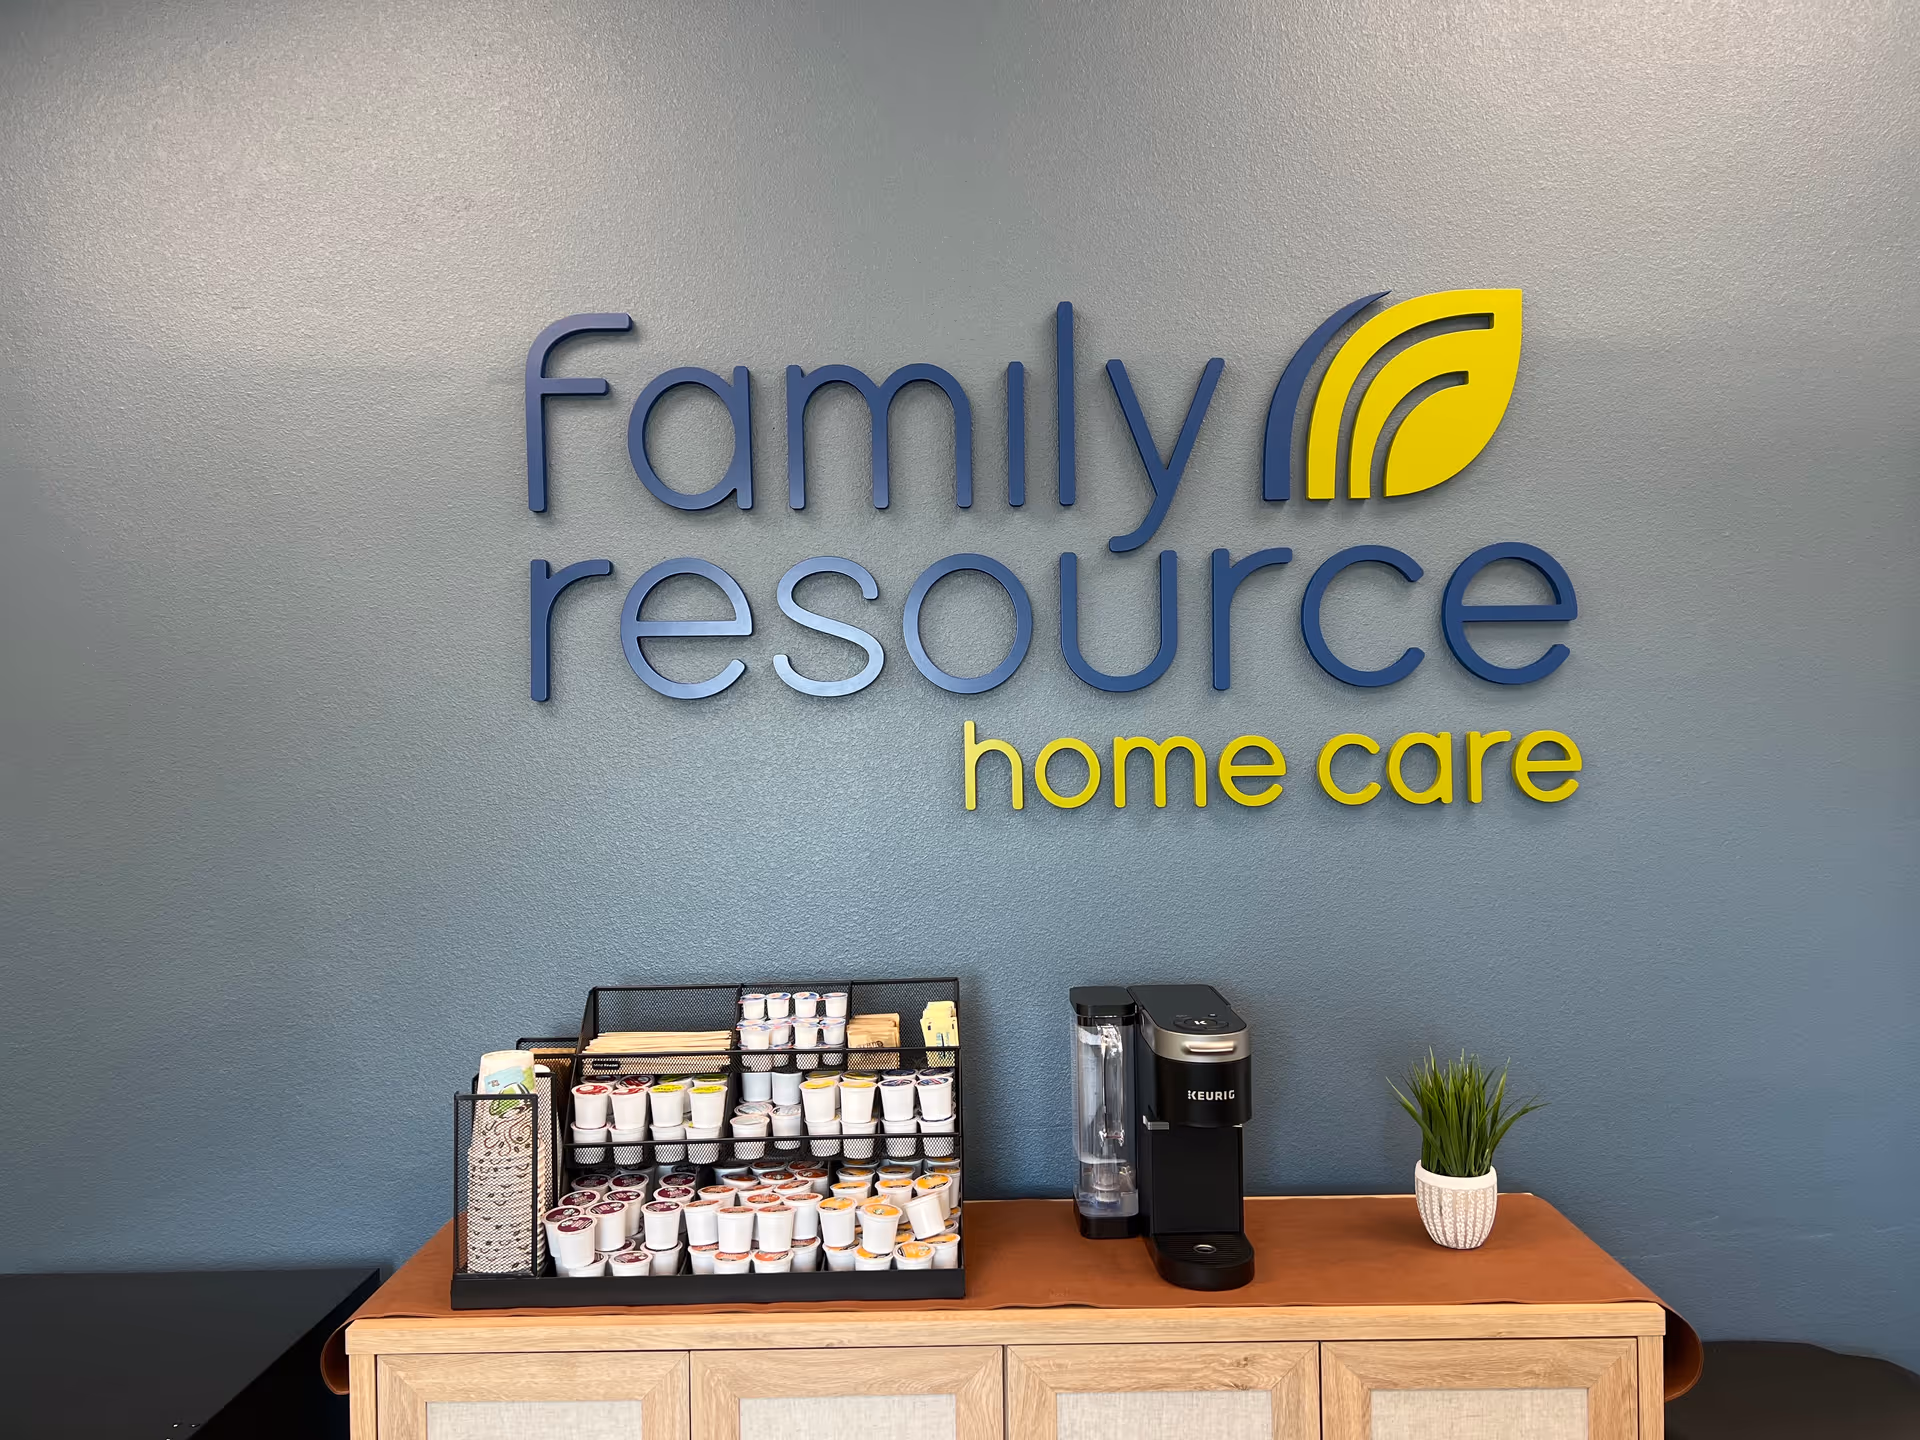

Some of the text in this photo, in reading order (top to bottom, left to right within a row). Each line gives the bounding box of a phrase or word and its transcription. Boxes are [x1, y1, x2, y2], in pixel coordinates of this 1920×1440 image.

[526, 302, 1226, 552] family
[530, 542, 1578, 703] resource
[963, 721, 1584, 810] home care
[1187, 1090, 1235, 1101] KEURIG
